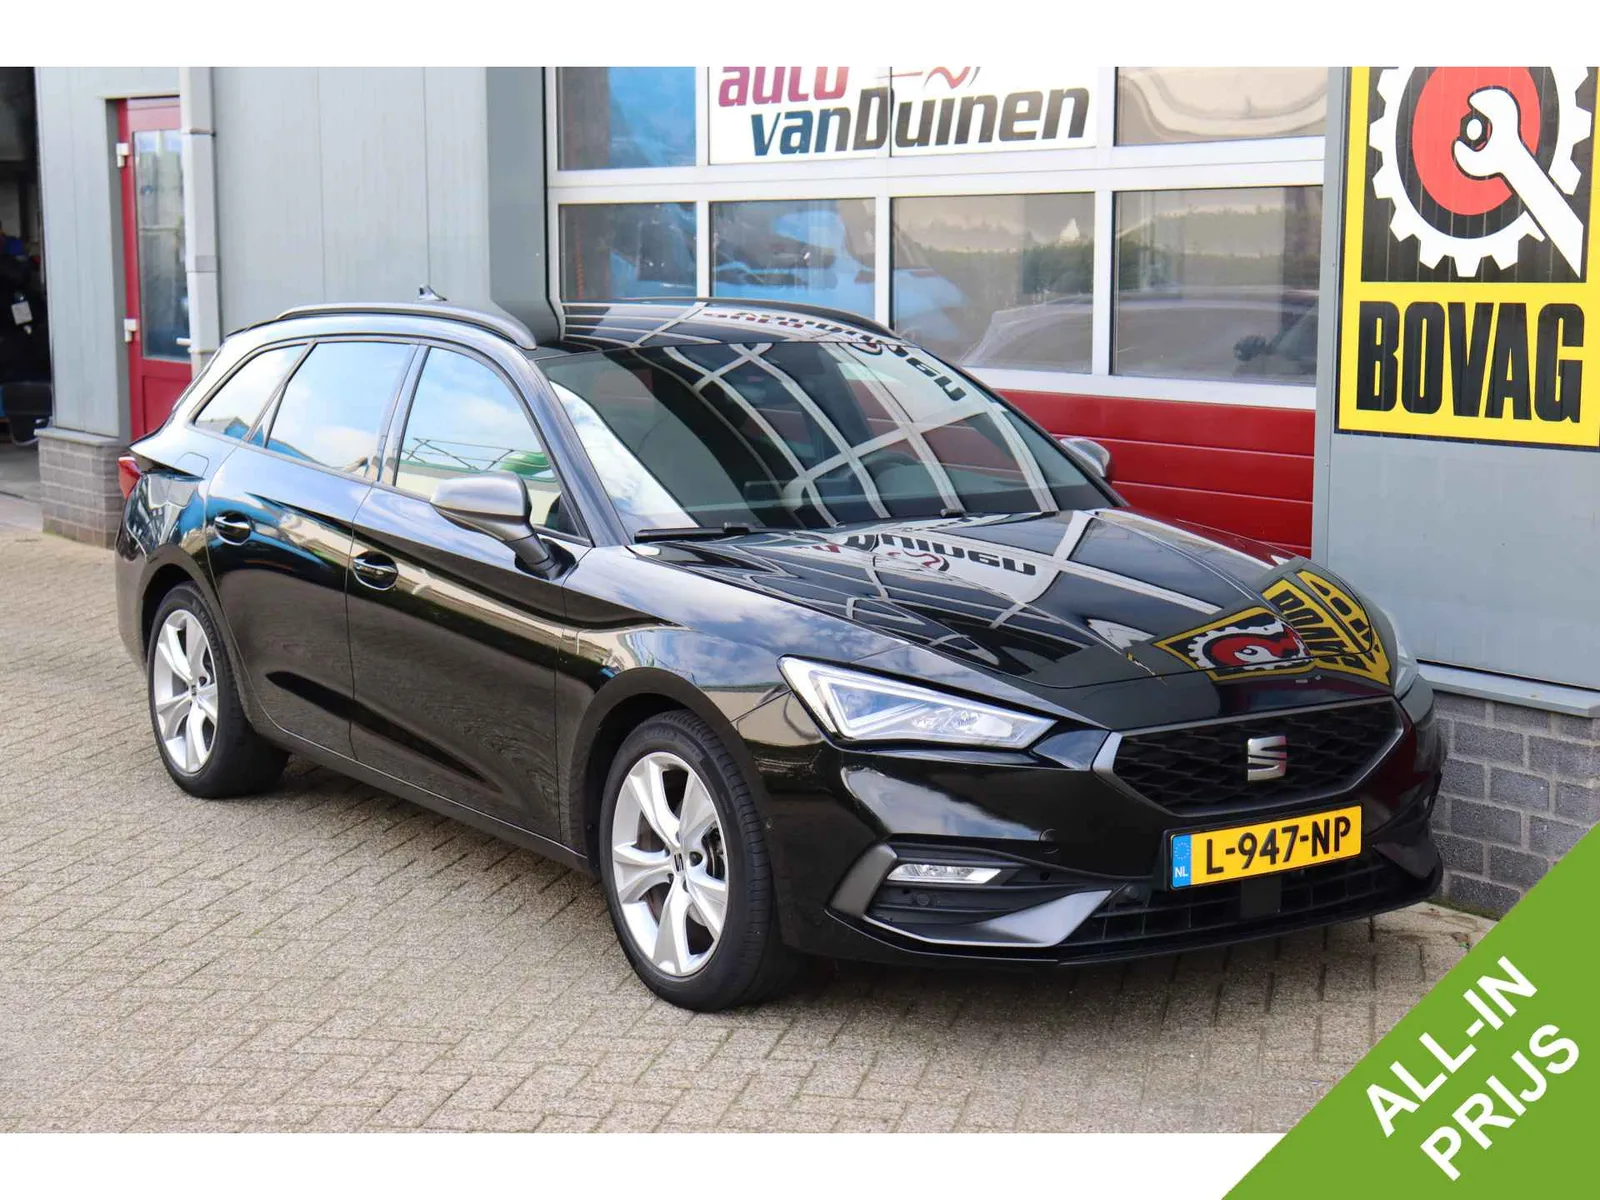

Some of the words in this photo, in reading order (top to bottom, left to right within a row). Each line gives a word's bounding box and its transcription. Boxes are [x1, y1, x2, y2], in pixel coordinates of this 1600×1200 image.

[1356, 301, 1585, 423] BOVAG
[1174, 866, 1189, 879] NL
[1206, 816, 1351, 876] L-947-NP
